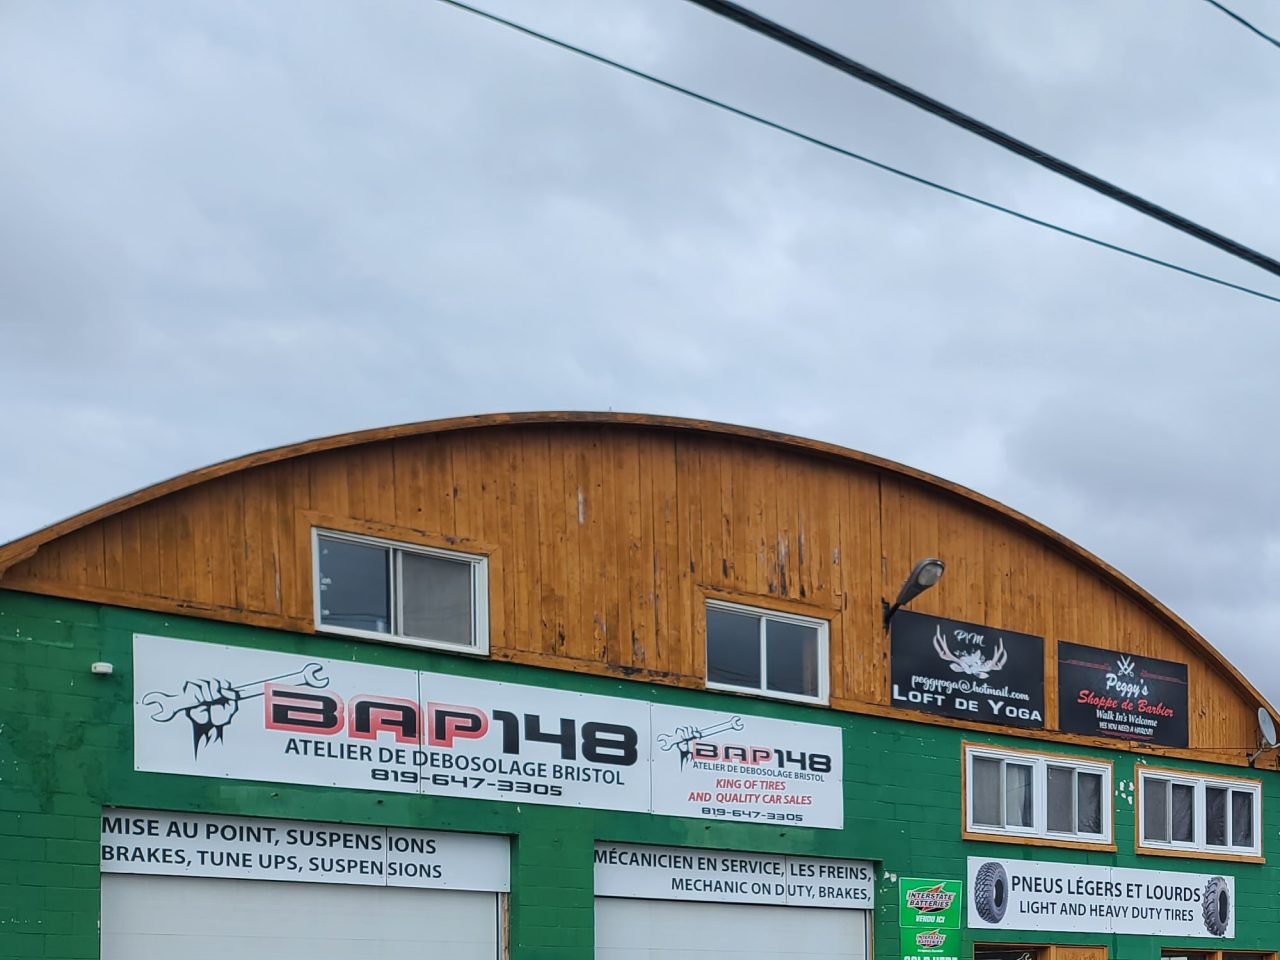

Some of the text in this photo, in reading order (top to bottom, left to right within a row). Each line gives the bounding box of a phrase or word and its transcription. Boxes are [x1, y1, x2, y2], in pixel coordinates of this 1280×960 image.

[911, 675, 1029, 700] peggyoga@hotmail.com
[1105, 673, 1149, 698] Peggy's
[1077, 690, 1174, 717] Shoppe de Barbier
[264, 682, 638, 766] BAP148
[1096, 709, 1114, 720] Walk
[1128, 714, 1158, 727] Welcome
[285, 738, 625, 786] ATELIER DE DEBOSOLAGE BRISTOL
[692, 741, 832, 774] BAP148
[371, 768, 563, 797] 819-647-3305
[693, 762, 825, 782] ATELIER DE DEBOSOLAGE BRISTOL
[716, 778, 786, 791] KING OF TIRES
[688, 792, 812, 805] AND QUALITY CAR SALES
[701, 807, 803, 822] 819-647-3305
[102, 816, 160, 836] MISE
[166, 820, 199, 839] AU
[205, 823, 281, 847] POINT,
[101, 844, 192, 868] BRAKES,
[197, 849, 253, 868] TUNE
[258, 853, 304, 873] UPS,
[594, 847, 872, 883] MÉCANICIEN EN SERVICE, LES FREINS,
[671, 877, 871, 902] MECHANIC ON DUTY, BRAKES,
[908, 892, 953, 900] INTERSTATE
[1011, 875, 1200, 902] PNEUS LÉGERS ET LOURDS
[916, 915, 935, 923] VENDU
[1019, 901, 1194, 922] LIGHT AND HEAVY DUTY TIRES
